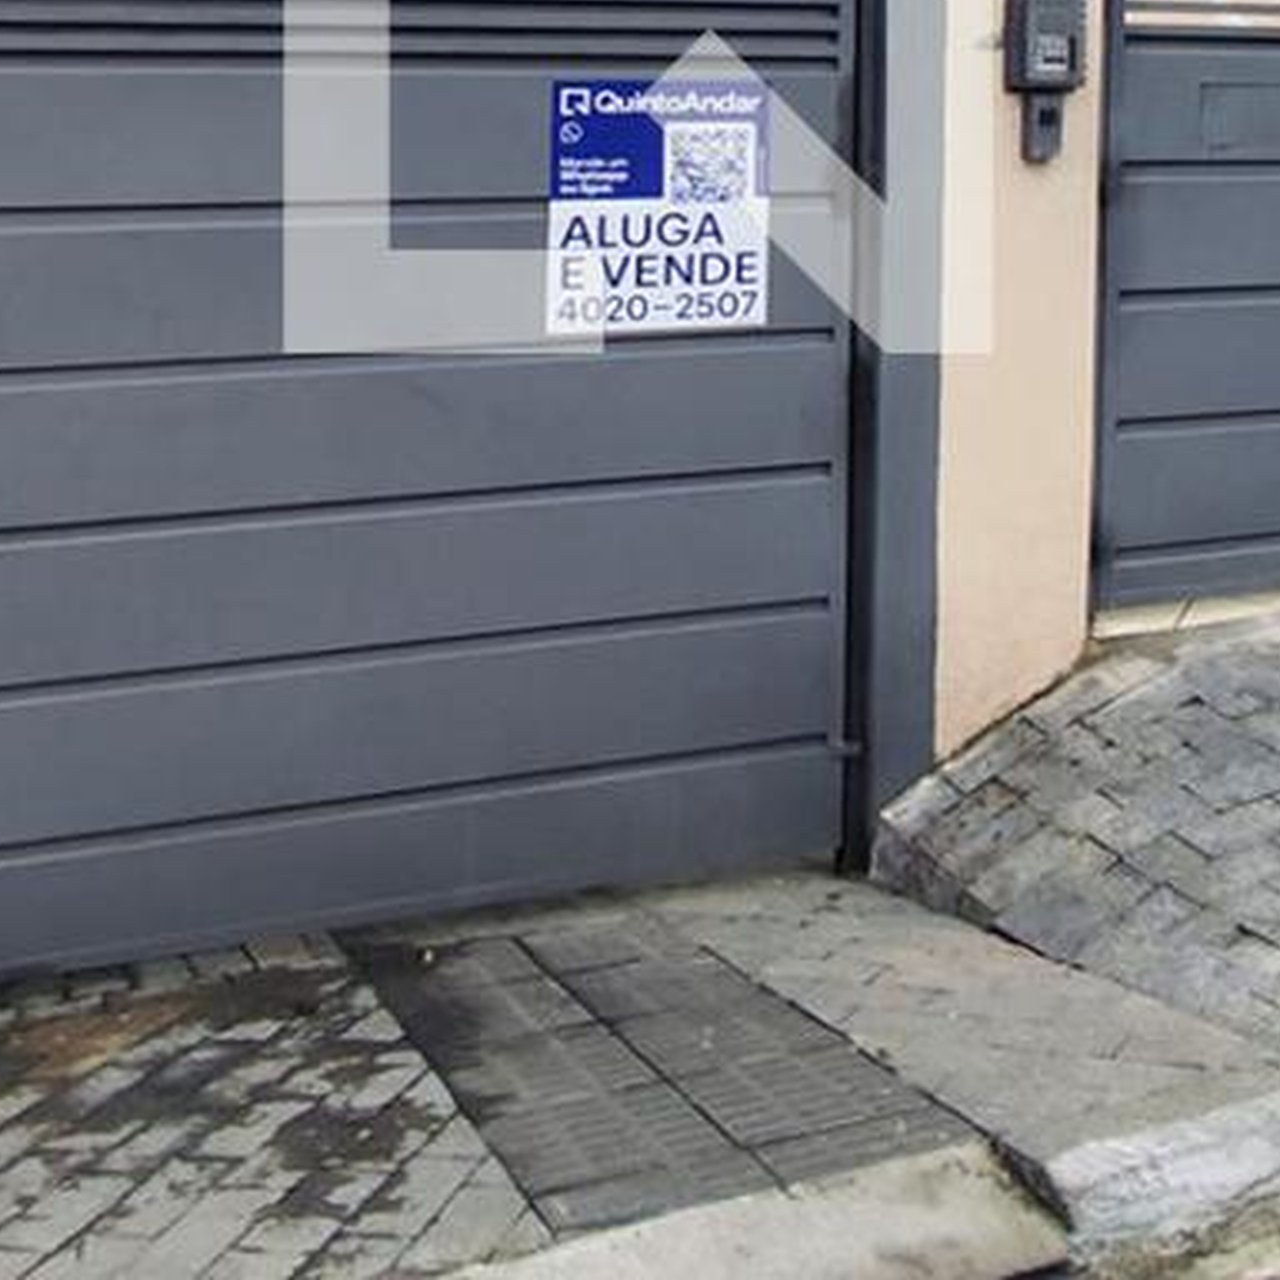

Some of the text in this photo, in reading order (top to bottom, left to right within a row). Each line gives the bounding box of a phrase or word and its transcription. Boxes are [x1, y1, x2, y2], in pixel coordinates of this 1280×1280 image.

[594, 88, 762, 114] QuintoAndar
[560, 212, 724, 250] ALUGA
[561, 251, 758, 290] E VENDE
[558, 291, 758, 323] 4020-2507
